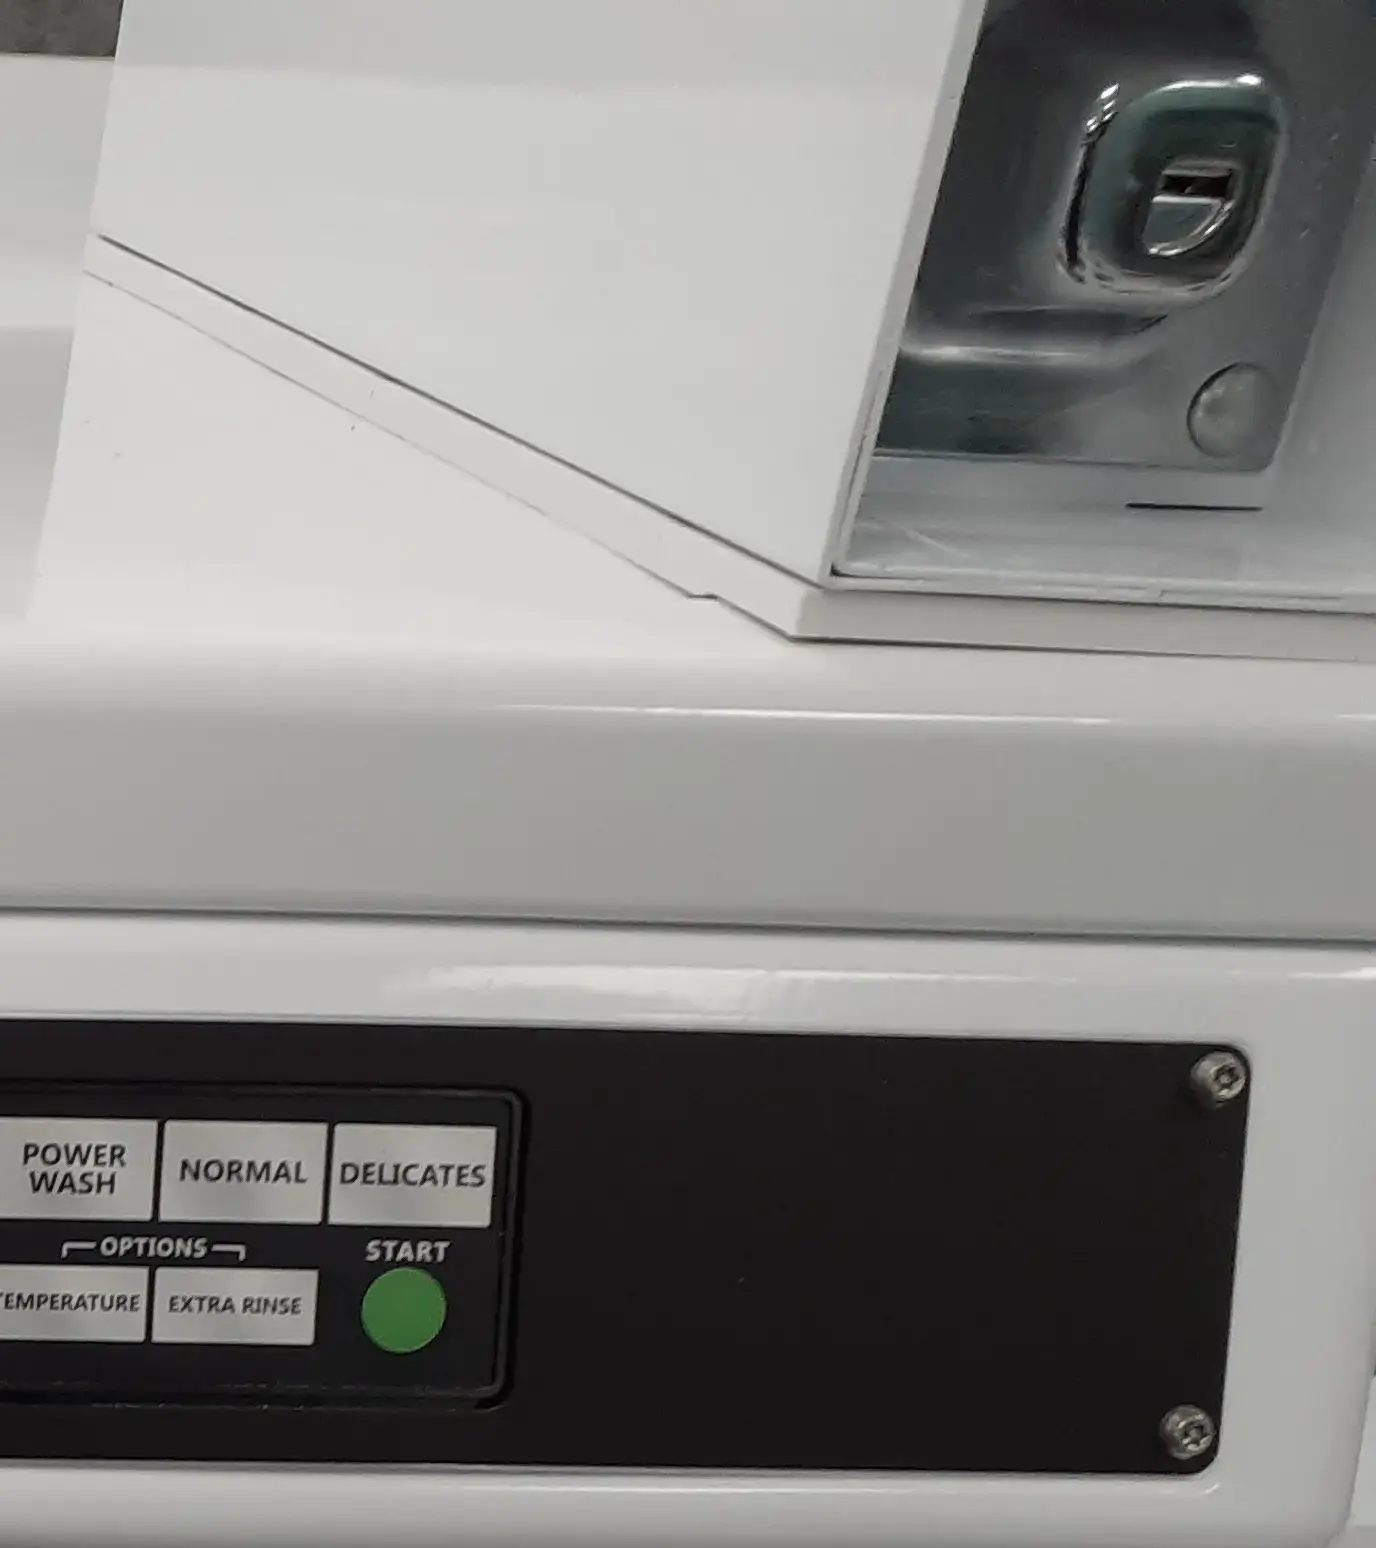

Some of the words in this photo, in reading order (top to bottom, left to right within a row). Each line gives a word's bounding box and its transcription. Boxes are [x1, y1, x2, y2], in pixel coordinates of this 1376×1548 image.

[23, 1142, 127, 1169] POWER
[29, 1169, 117, 1196] WASH
[179, 1158, 307, 1186] NORMAL
[339, 1161, 487, 1188] DELICATES
[100, 1236, 208, 1260] OPTIONS
[365, 1240, 451, 1263] START
[168, 1295, 236, 1315] EXTRA
[242, 1296, 303, 1316] RINSE
